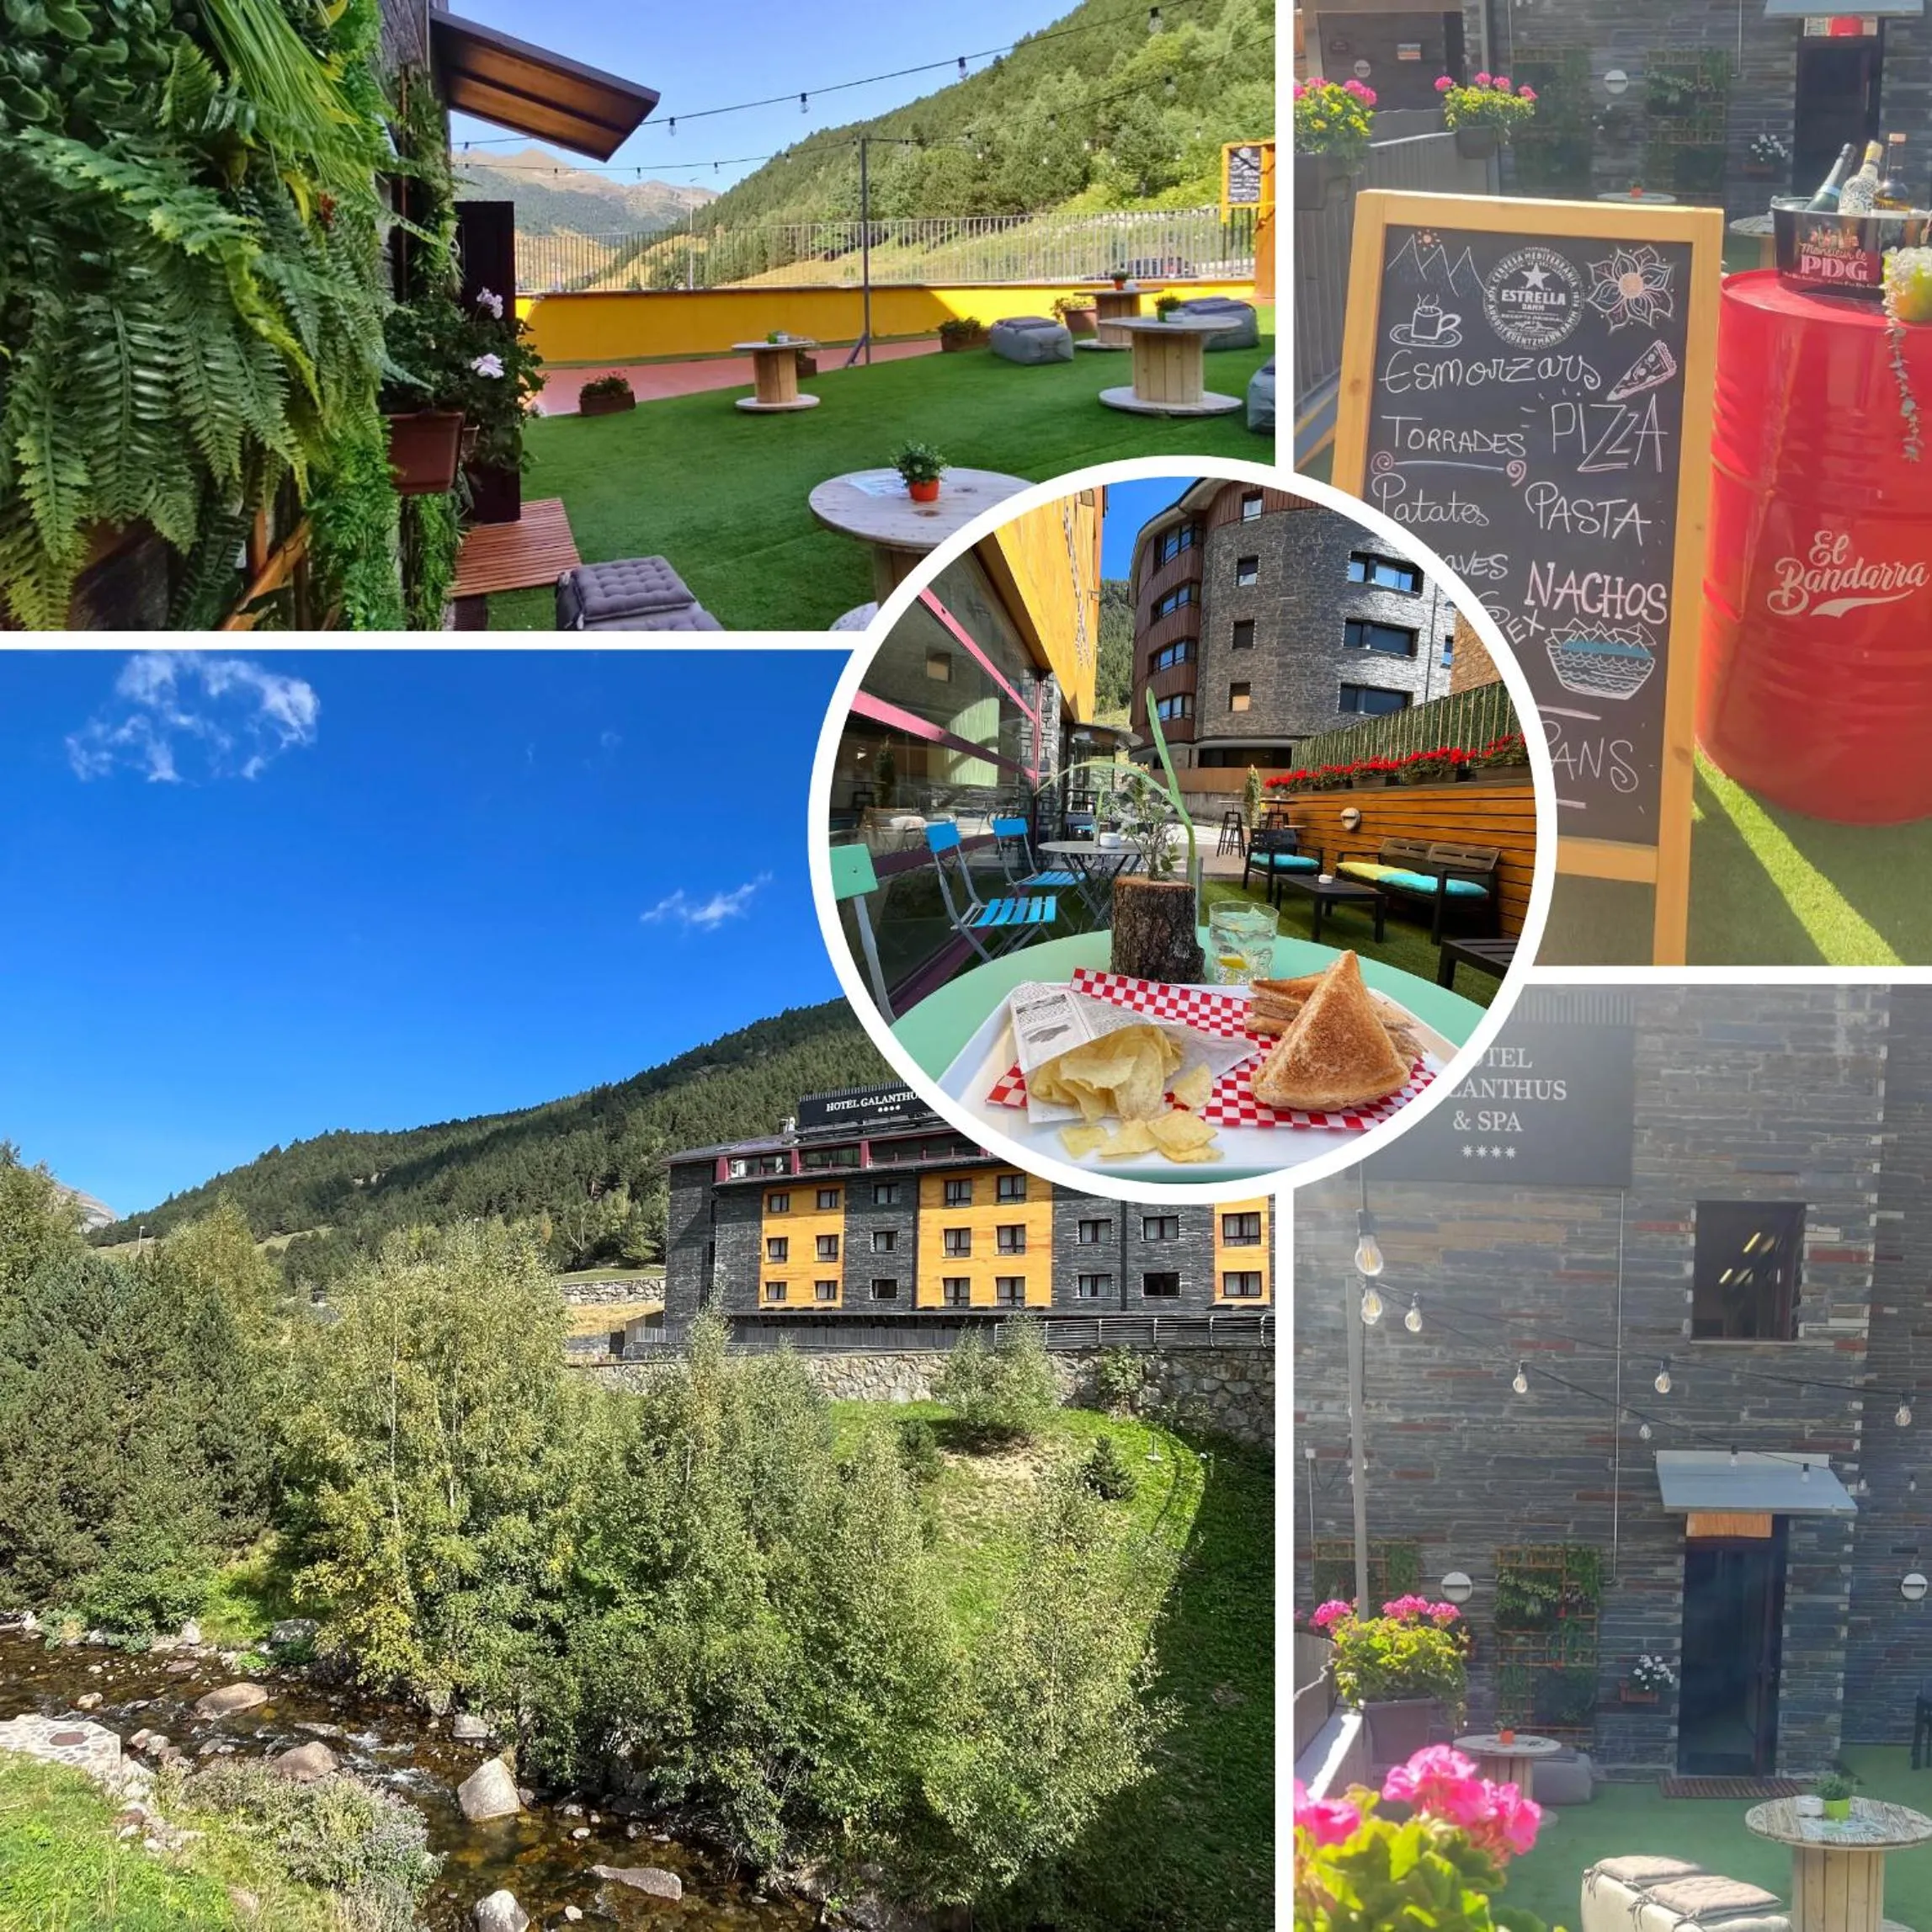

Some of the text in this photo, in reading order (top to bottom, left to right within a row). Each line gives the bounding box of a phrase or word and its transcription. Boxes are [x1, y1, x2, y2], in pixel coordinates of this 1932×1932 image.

[1801, 254, 1868, 281] PDG
[1501, 289, 1566, 306] ESTRELLA
[1521, 303, 1546, 311] DAMM
[1381, 415, 1526, 457] TORRADES
[1371, 472, 1490, 526] Patates
[1525, 482, 1652, 546] PASTA
[1809, 530, 1850, 567] El
[1524, 559, 1668, 625] NACHOS
[1767, 556, 1930, 615] Bandarra
[1476, 1047, 1533, 1068] TEL
[826, 1091, 918, 1112] HOTEL GALANTHU
[1449, 1078, 1567, 1100] ANTHUS
[1453, 1110, 1525, 1131] & SPA
